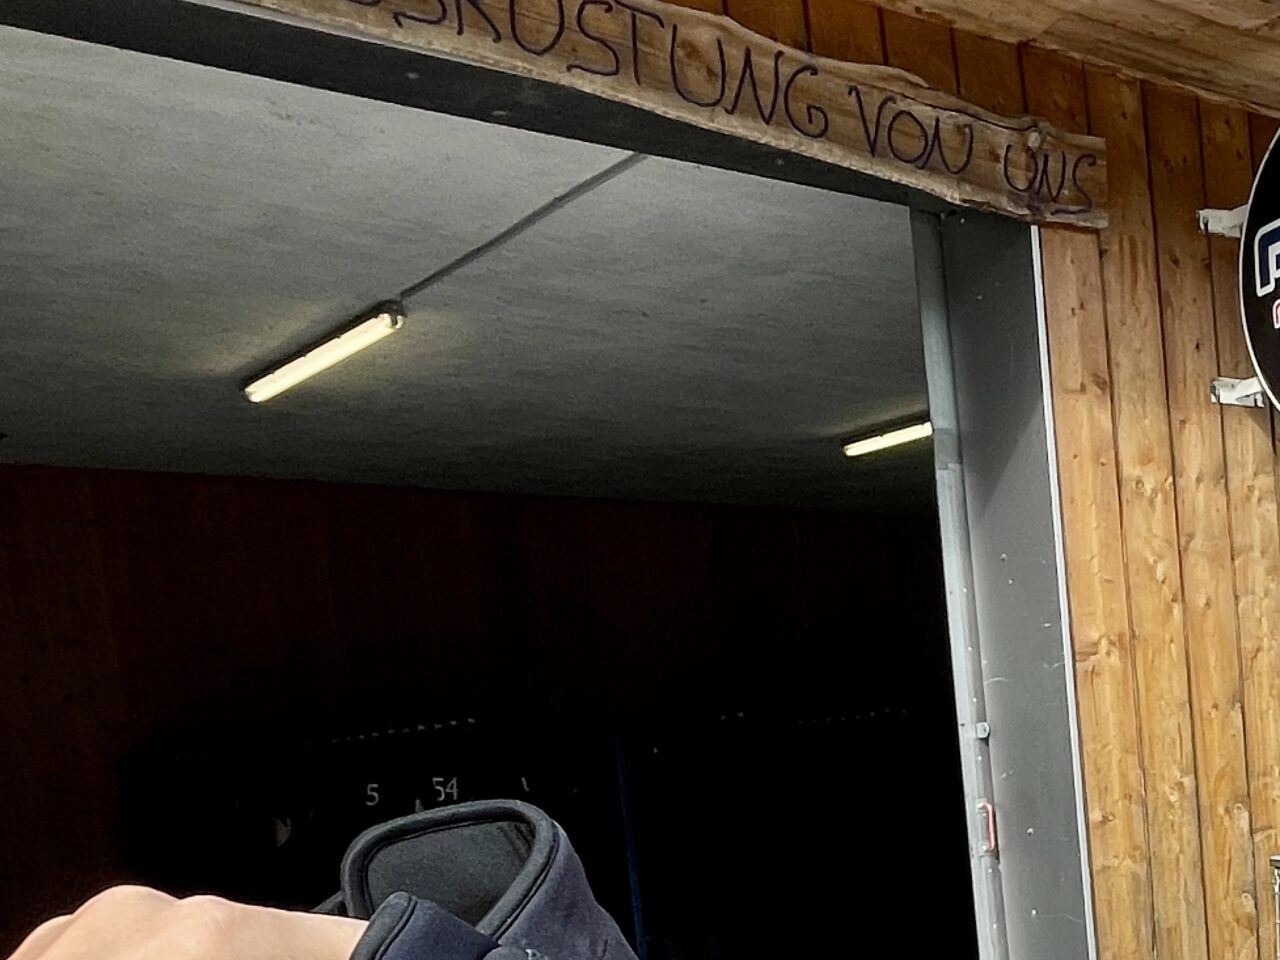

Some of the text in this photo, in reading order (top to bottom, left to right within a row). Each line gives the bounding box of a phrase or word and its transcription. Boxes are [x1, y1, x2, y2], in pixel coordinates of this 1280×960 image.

[847, 84, 974, 175] VON
[1003, 143, 1096, 215] UNS
[431, 777, 458, 801] 54
